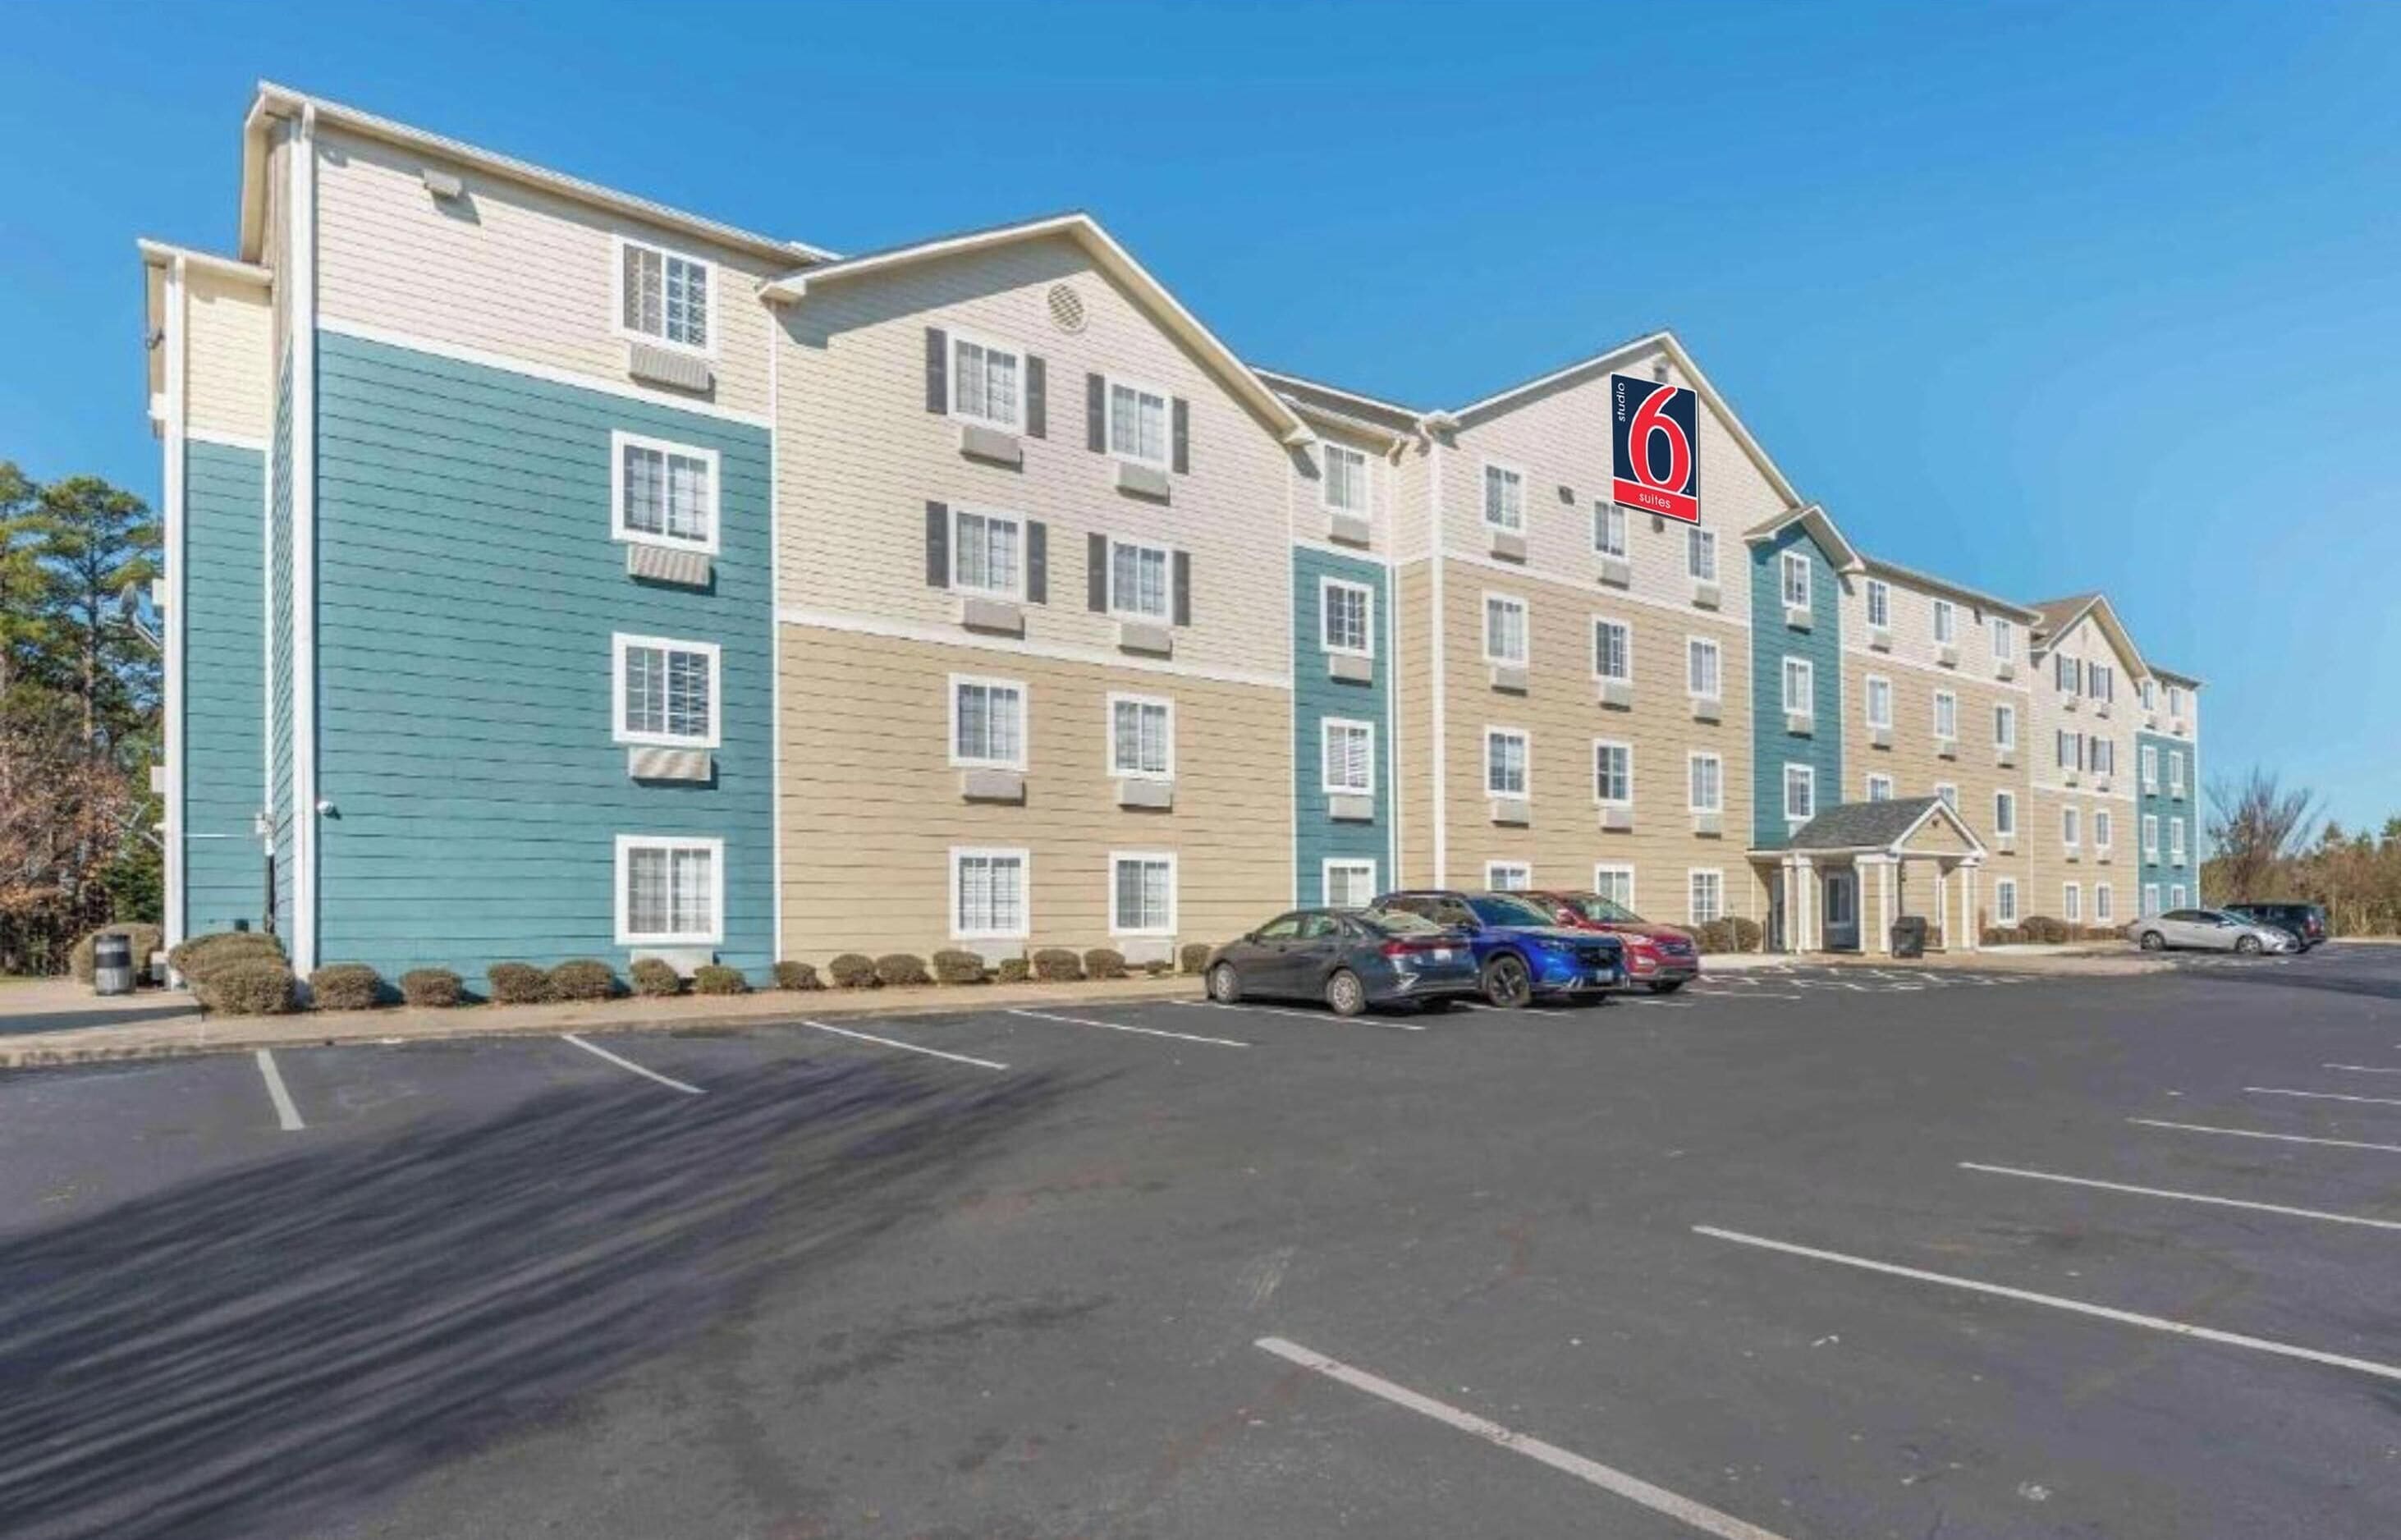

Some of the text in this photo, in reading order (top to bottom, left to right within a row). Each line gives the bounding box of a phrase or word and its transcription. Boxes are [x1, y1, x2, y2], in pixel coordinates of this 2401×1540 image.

[1616, 383, 1626, 422] studio
[1629, 385, 1691, 493] 6
[1638, 493, 1671, 509] suites
